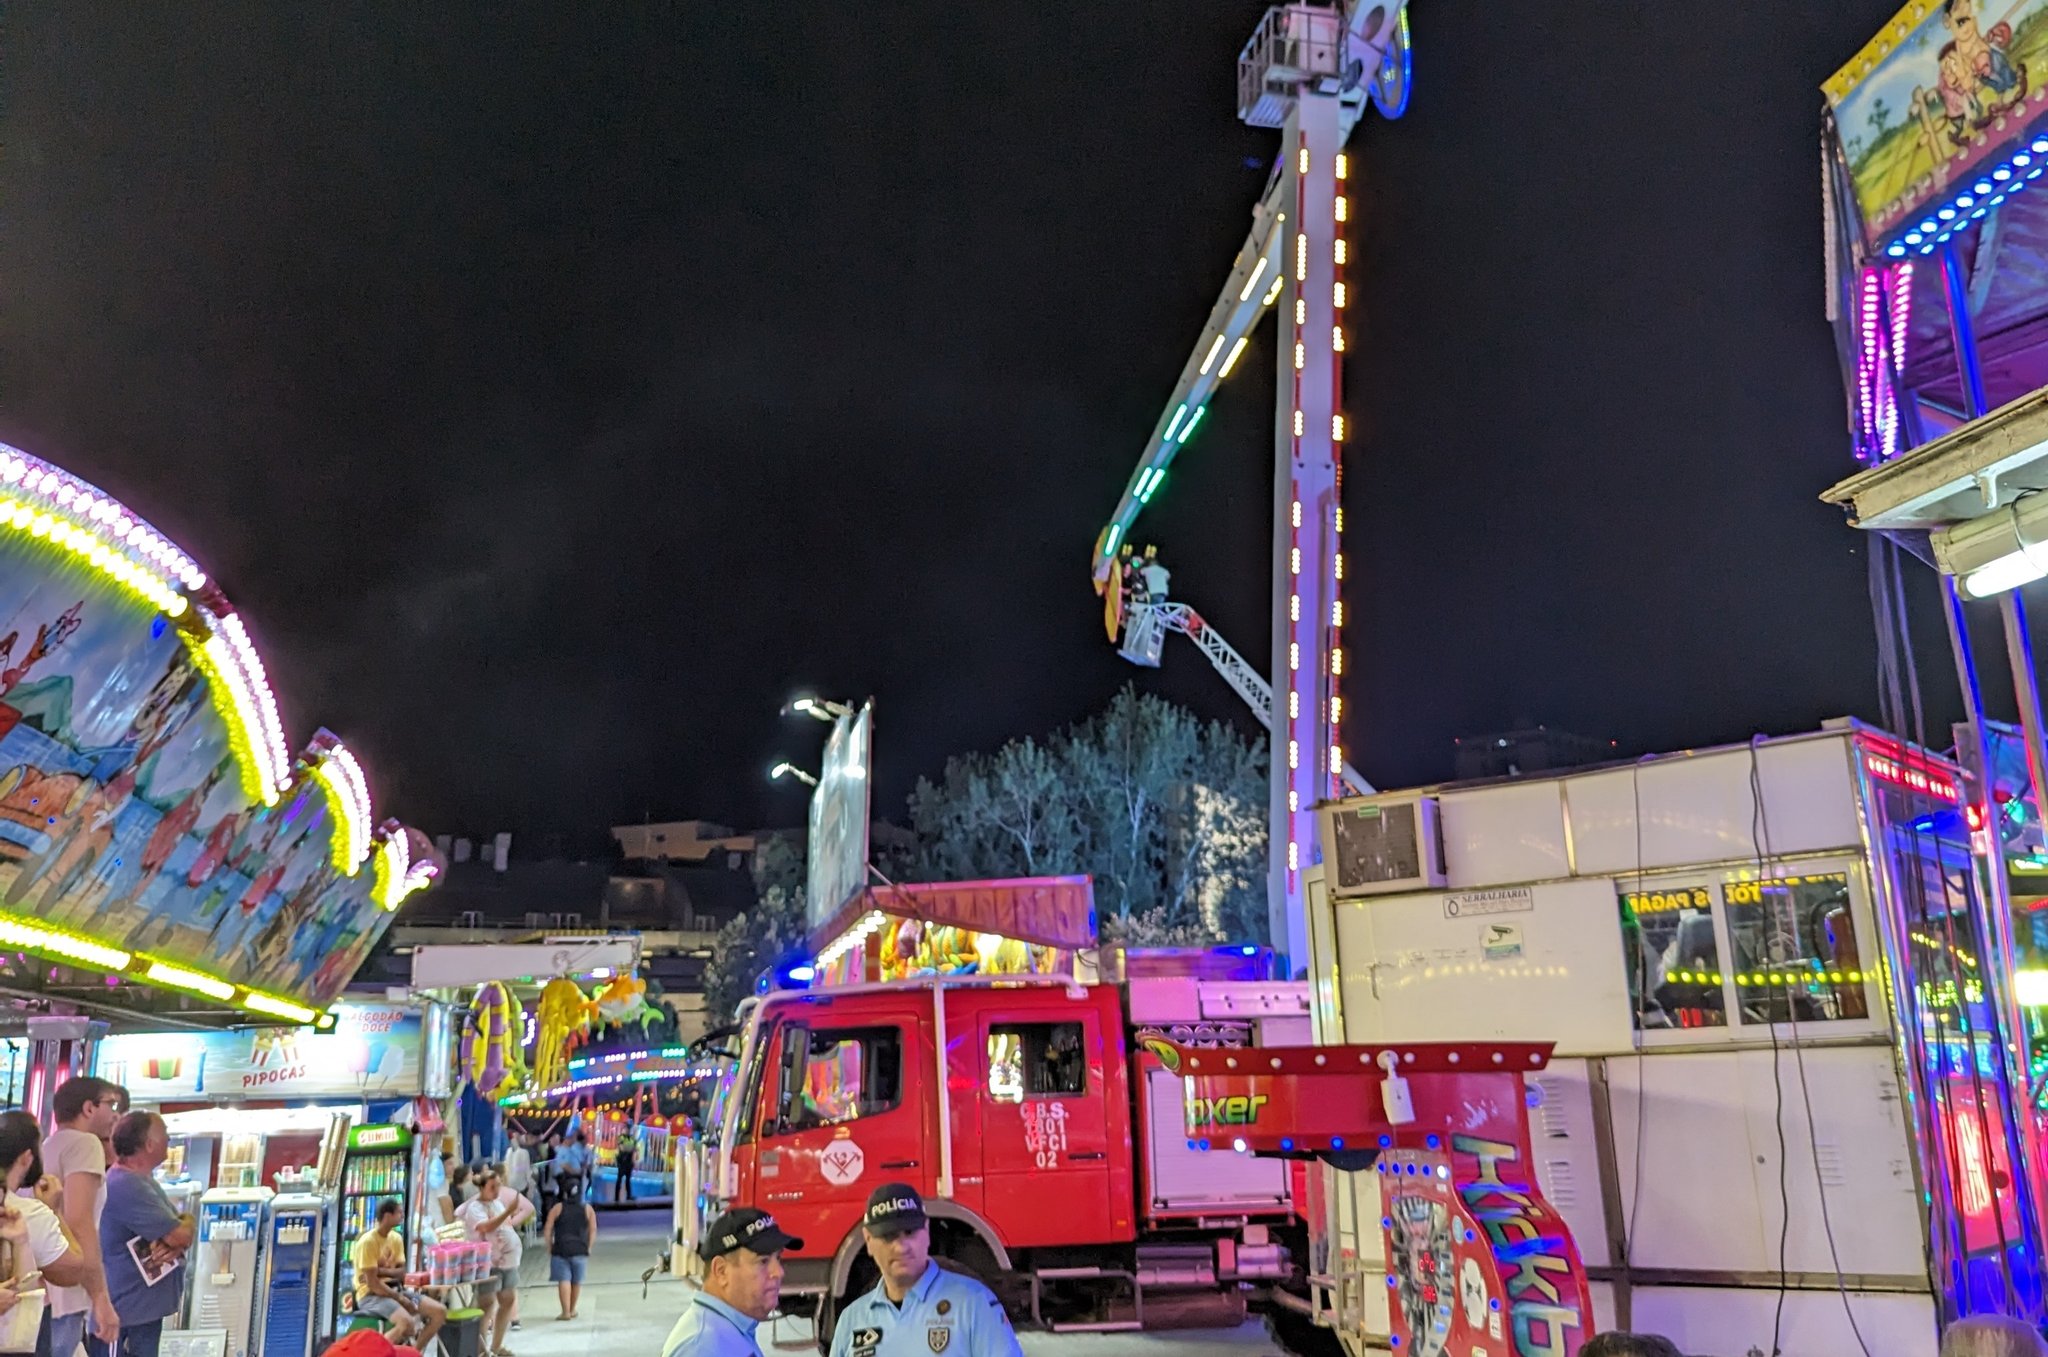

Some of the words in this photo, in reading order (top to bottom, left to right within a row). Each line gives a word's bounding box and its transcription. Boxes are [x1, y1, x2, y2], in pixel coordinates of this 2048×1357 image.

[362, 1022, 391, 1032] DOCE
[242, 1064, 306, 1088] PIPOCAS
[1036, 1150, 1058, 1168] 02
